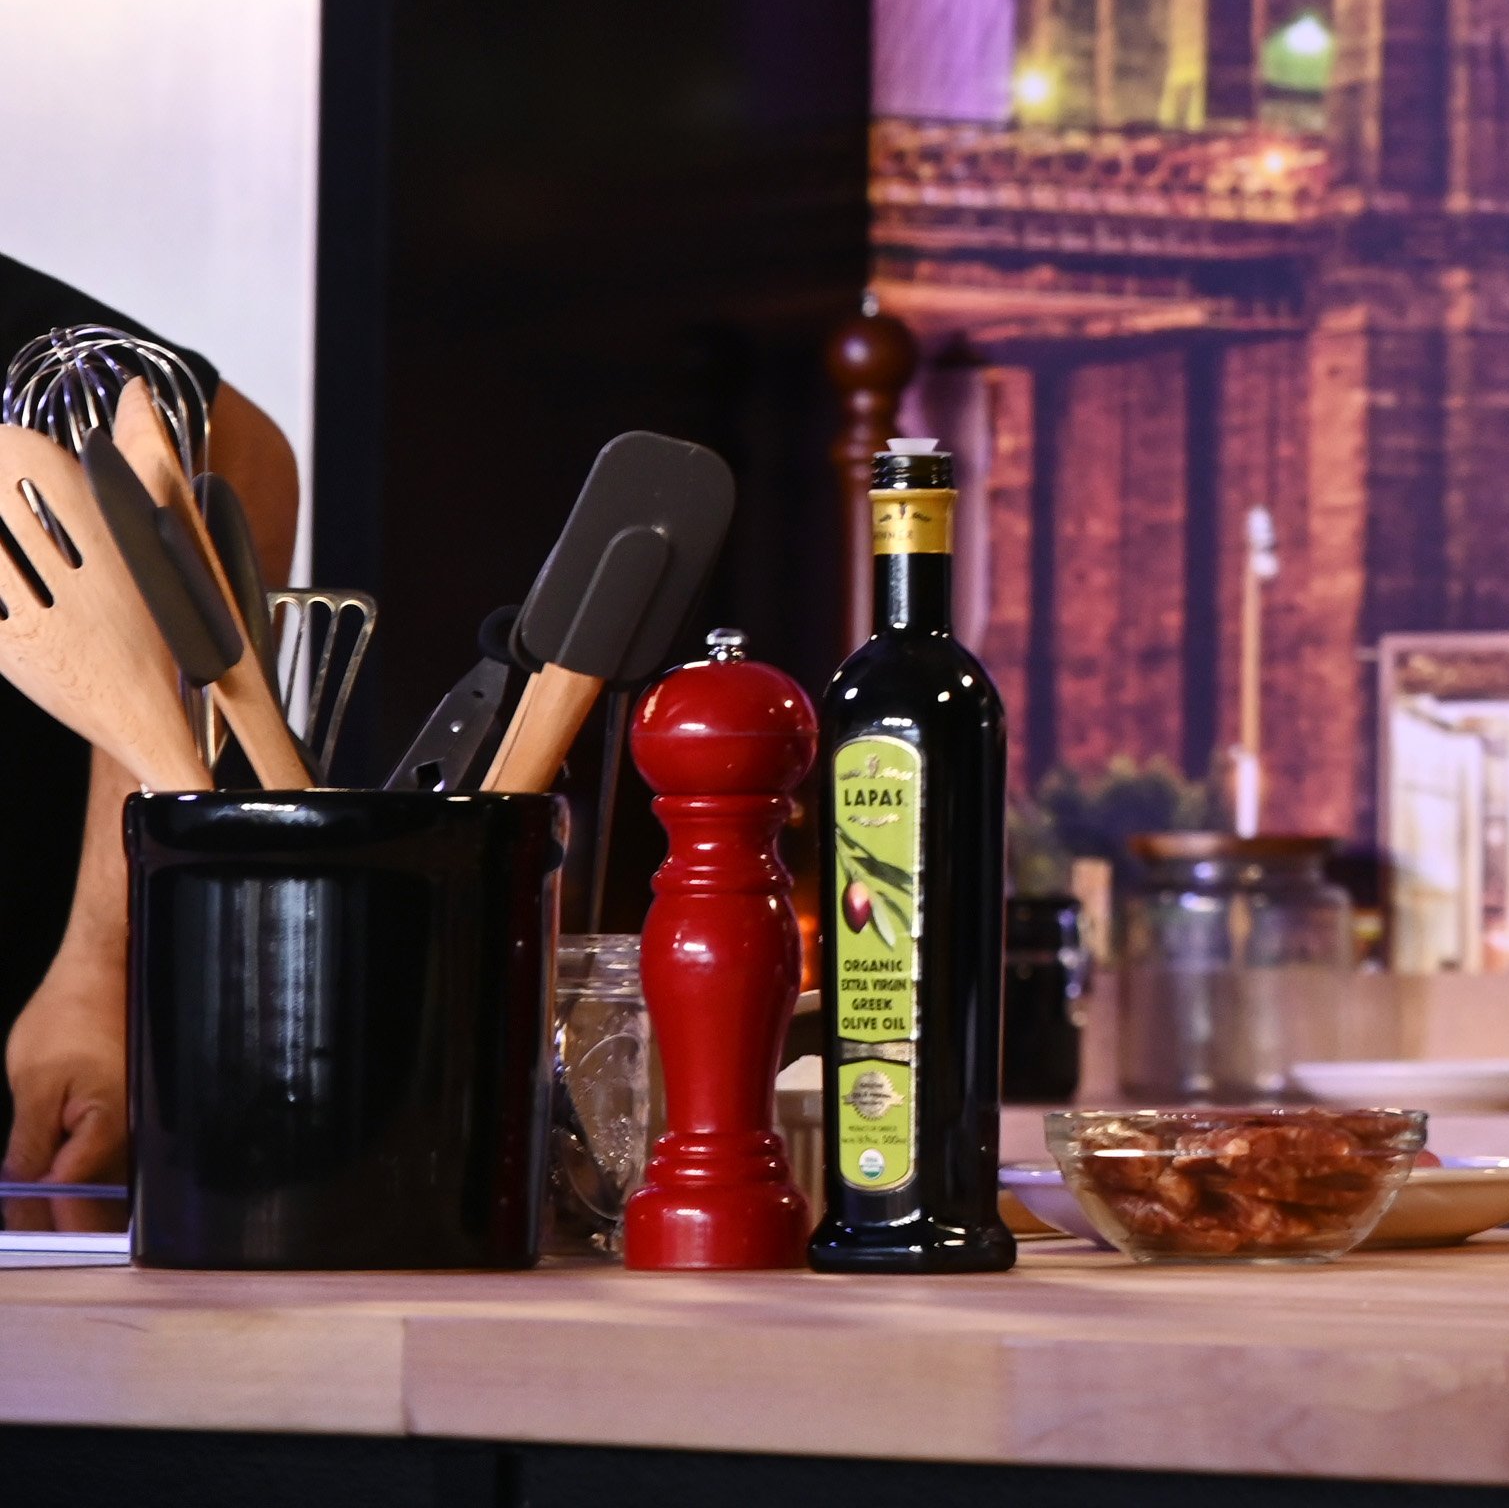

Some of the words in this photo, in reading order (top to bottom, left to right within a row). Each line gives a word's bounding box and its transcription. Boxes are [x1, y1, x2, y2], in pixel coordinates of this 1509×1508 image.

[844, 788, 903, 806] LAPAS
[843, 959, 903, 972] ORGANIC
[841, 978, 868, 991] EXTRA
[871, 978, 907, 991] VIRGIN
[851, 998, 893, 1010] GREEK
[841, 1017, 877, 1030] OLIVE
[882, 1017, 906, 1030] OIL
